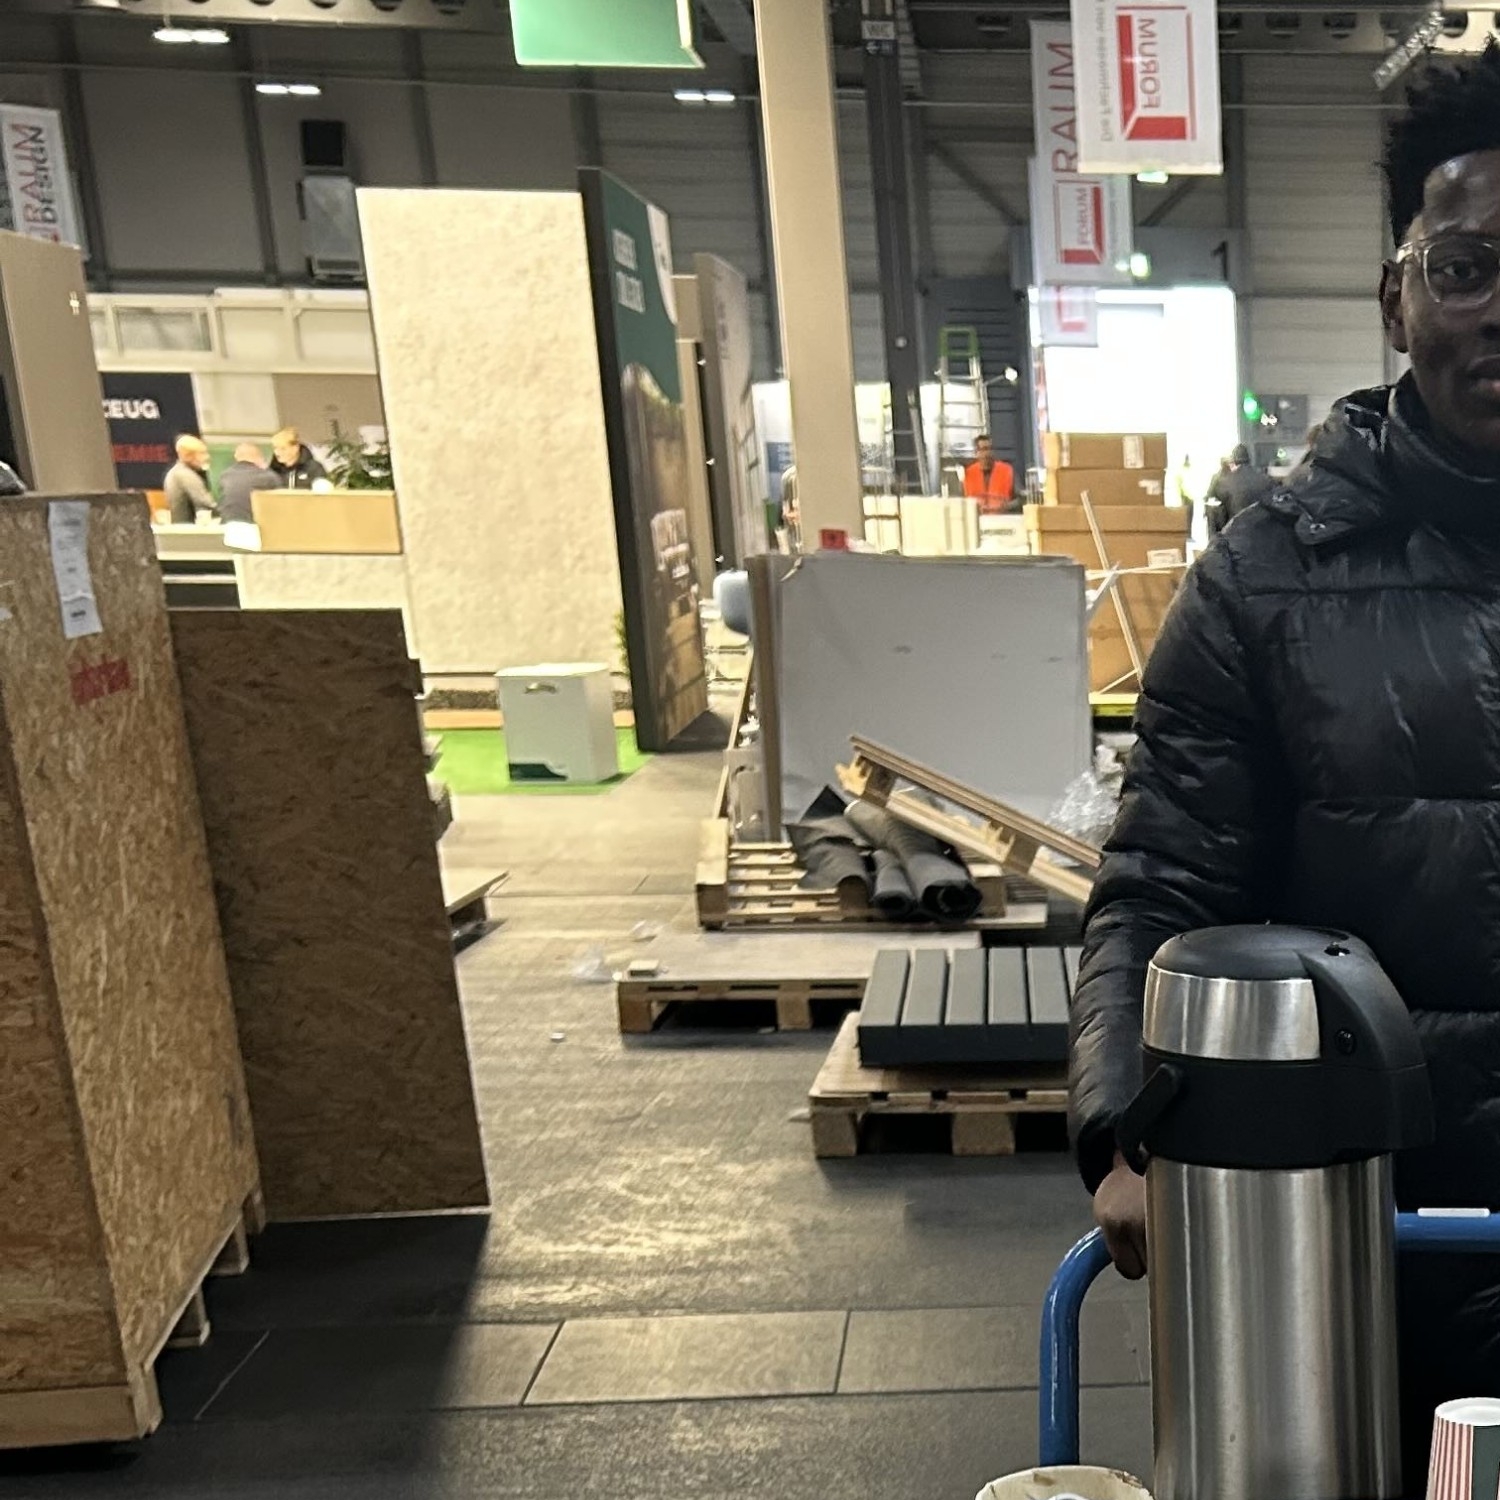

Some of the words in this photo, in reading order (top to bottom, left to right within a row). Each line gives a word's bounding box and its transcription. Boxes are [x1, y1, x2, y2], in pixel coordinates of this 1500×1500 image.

[1046, 43, 1078, 173] RAUM
[1076, 187, 1091, 245] FORUM
[1211, 240, 1229, 281] 1
